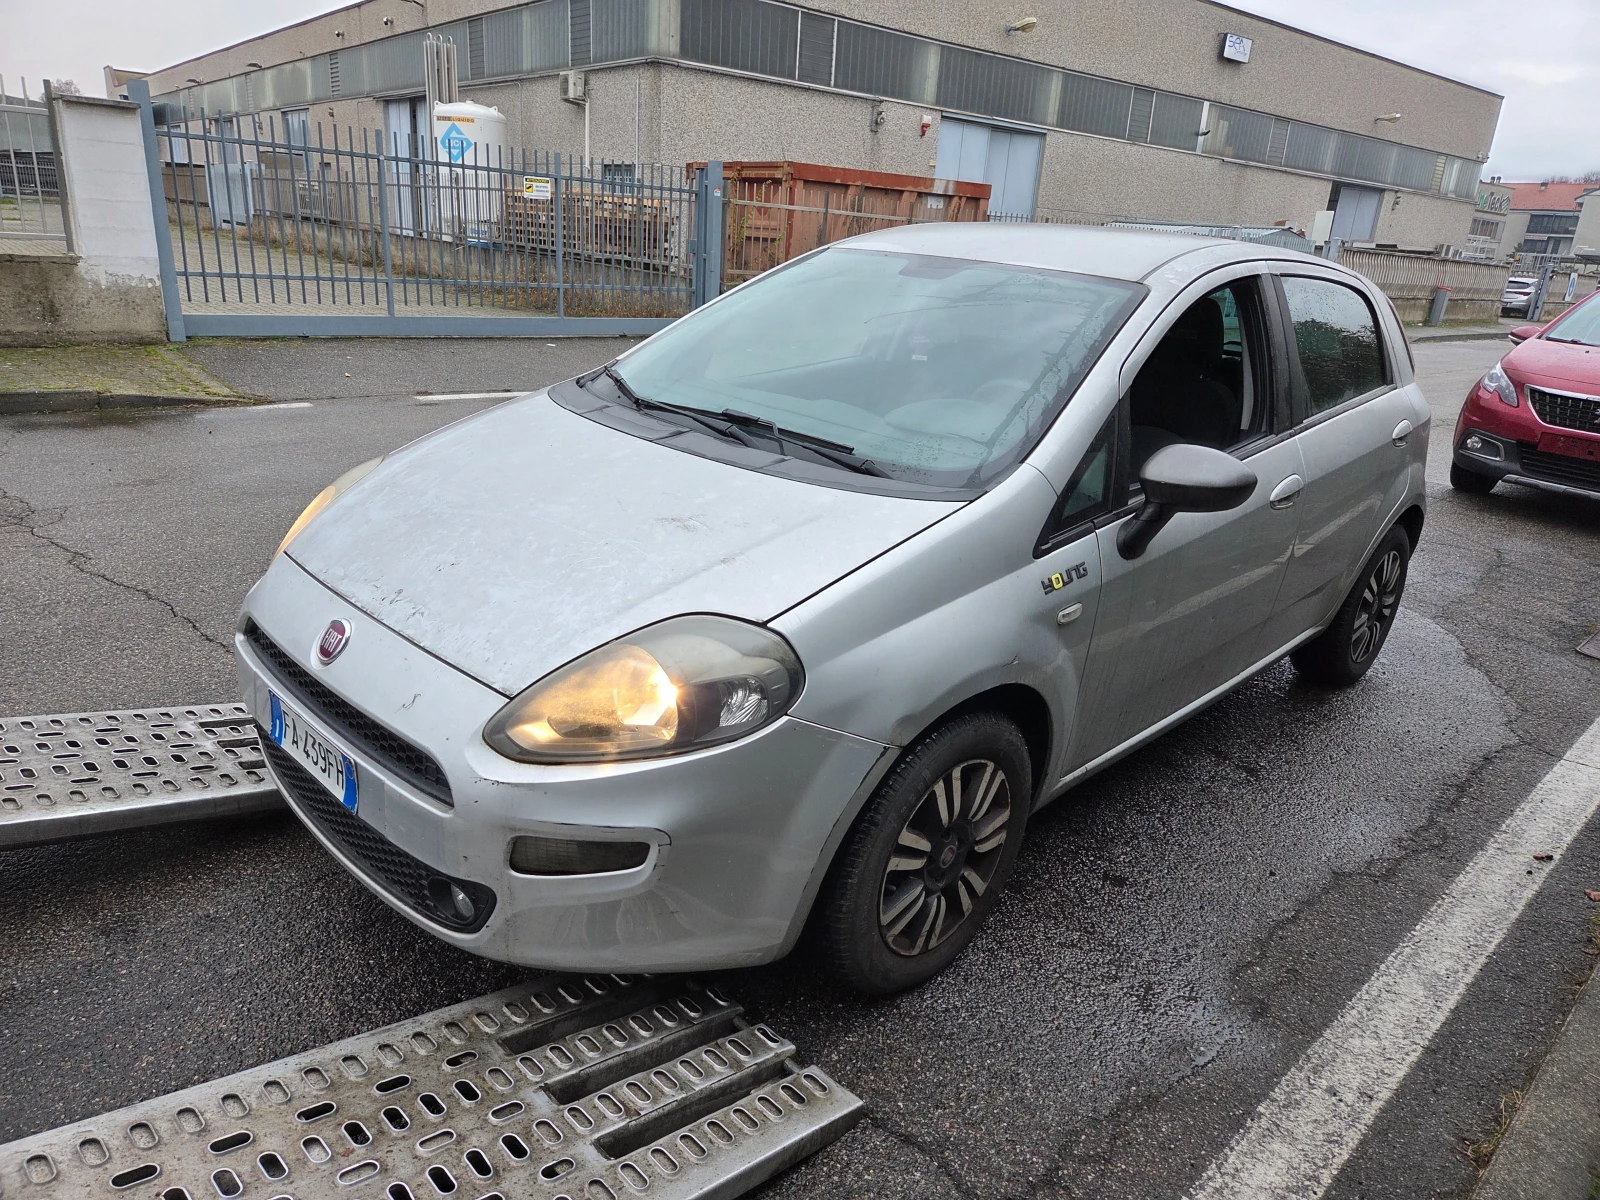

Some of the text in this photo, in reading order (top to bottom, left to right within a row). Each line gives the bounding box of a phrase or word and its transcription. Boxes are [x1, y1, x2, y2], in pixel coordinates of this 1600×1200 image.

[321, 628, 342, 653] FIAT
[282, 708, 344, 791] FA 439FH
